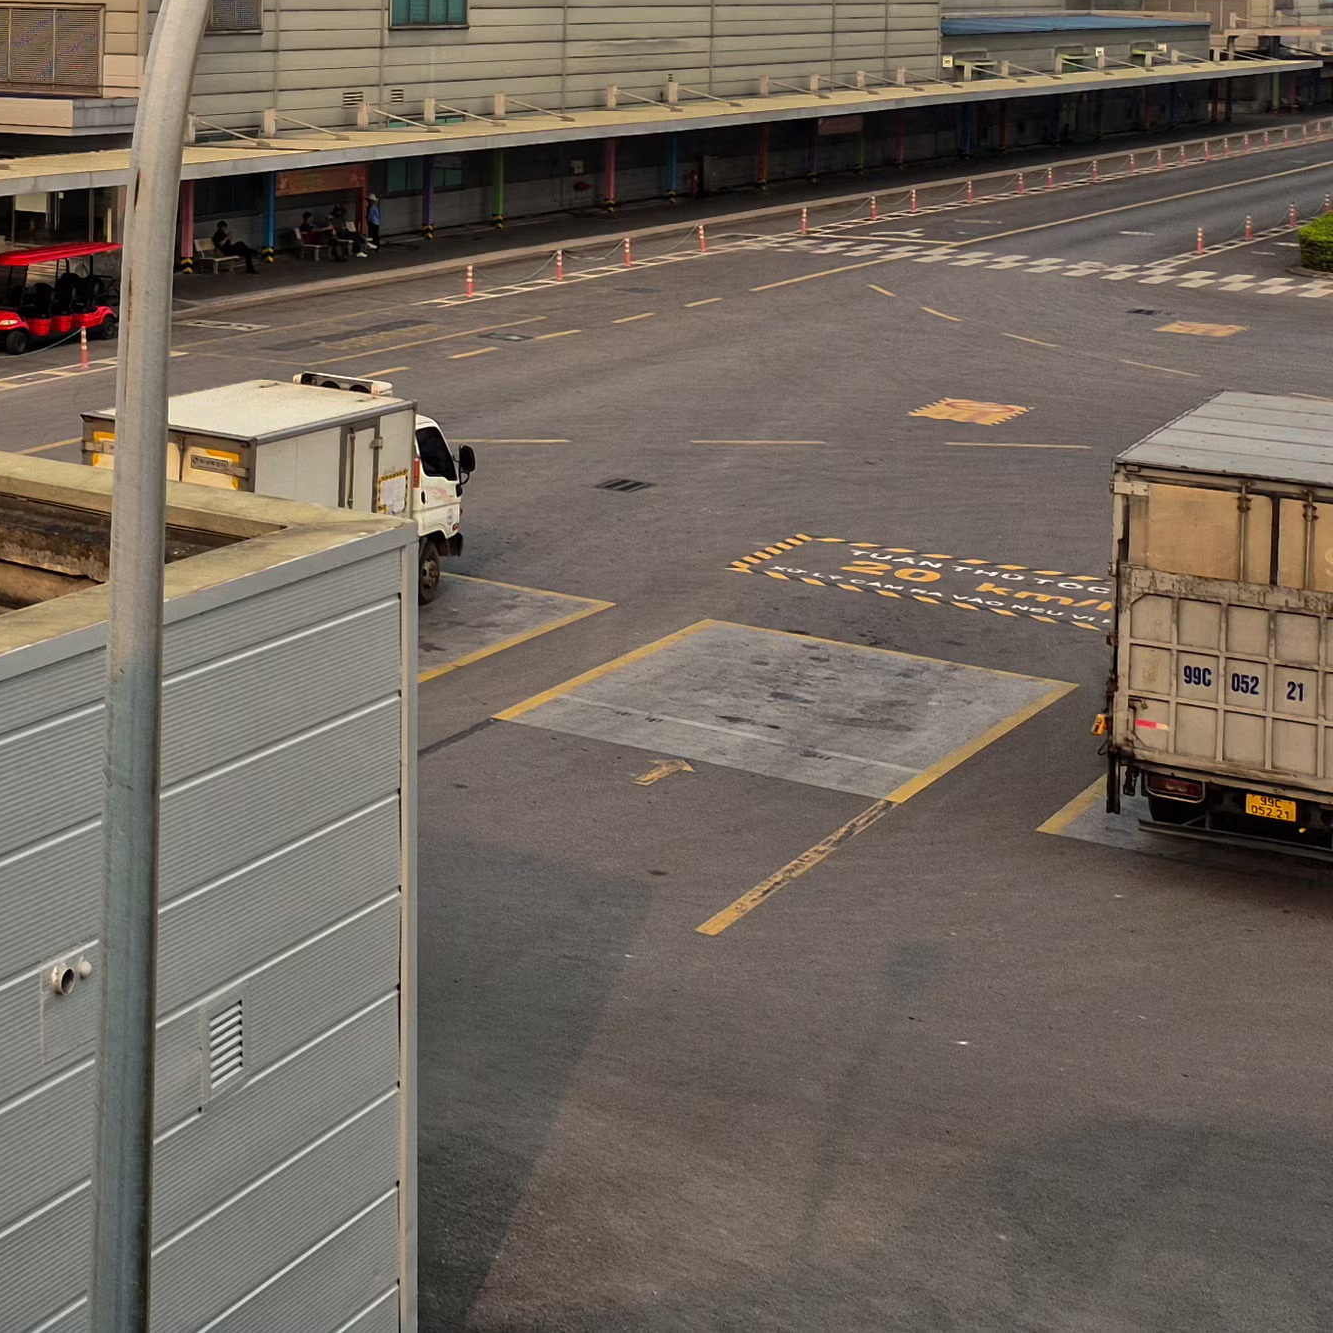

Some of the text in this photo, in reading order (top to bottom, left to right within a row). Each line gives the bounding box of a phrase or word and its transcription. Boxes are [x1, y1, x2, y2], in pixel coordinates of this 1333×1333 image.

[840, 560, 942, 583] 20
[1183, 665, 1305, 702] 99C 052 21
[1260, 796, 1282, 808] 99C
